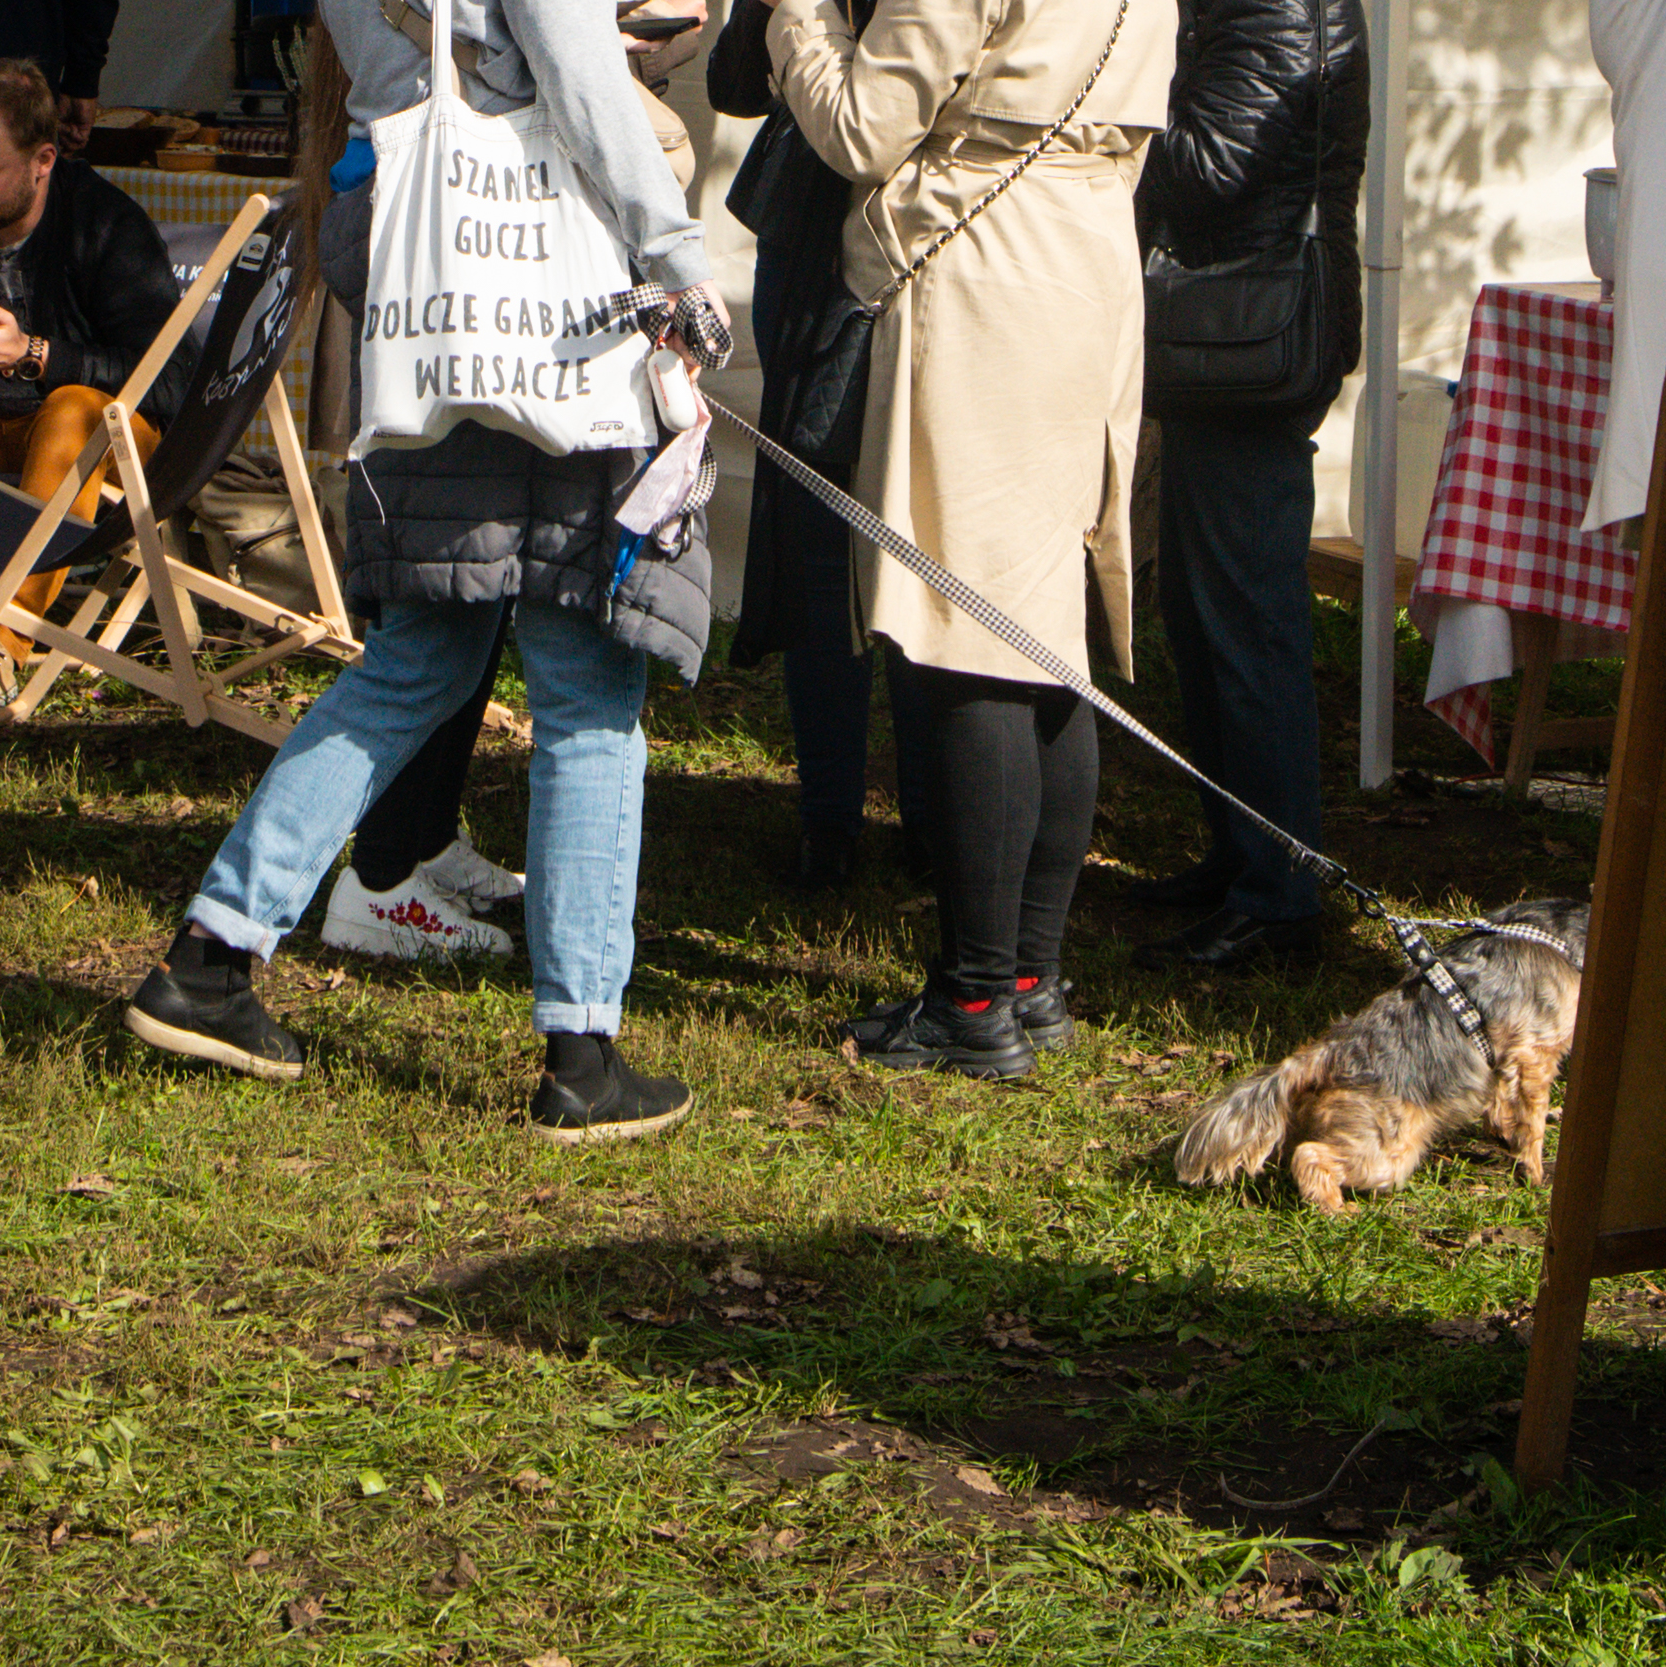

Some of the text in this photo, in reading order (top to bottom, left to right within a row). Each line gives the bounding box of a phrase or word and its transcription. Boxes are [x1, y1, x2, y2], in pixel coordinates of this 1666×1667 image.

[447, 149, 559, 202] SZANEL
[455, 215, 550, 261] GUCZI
[364, 292, 478, 342] DOLCZE
[415, 353, 591, 402] WERSACZE
